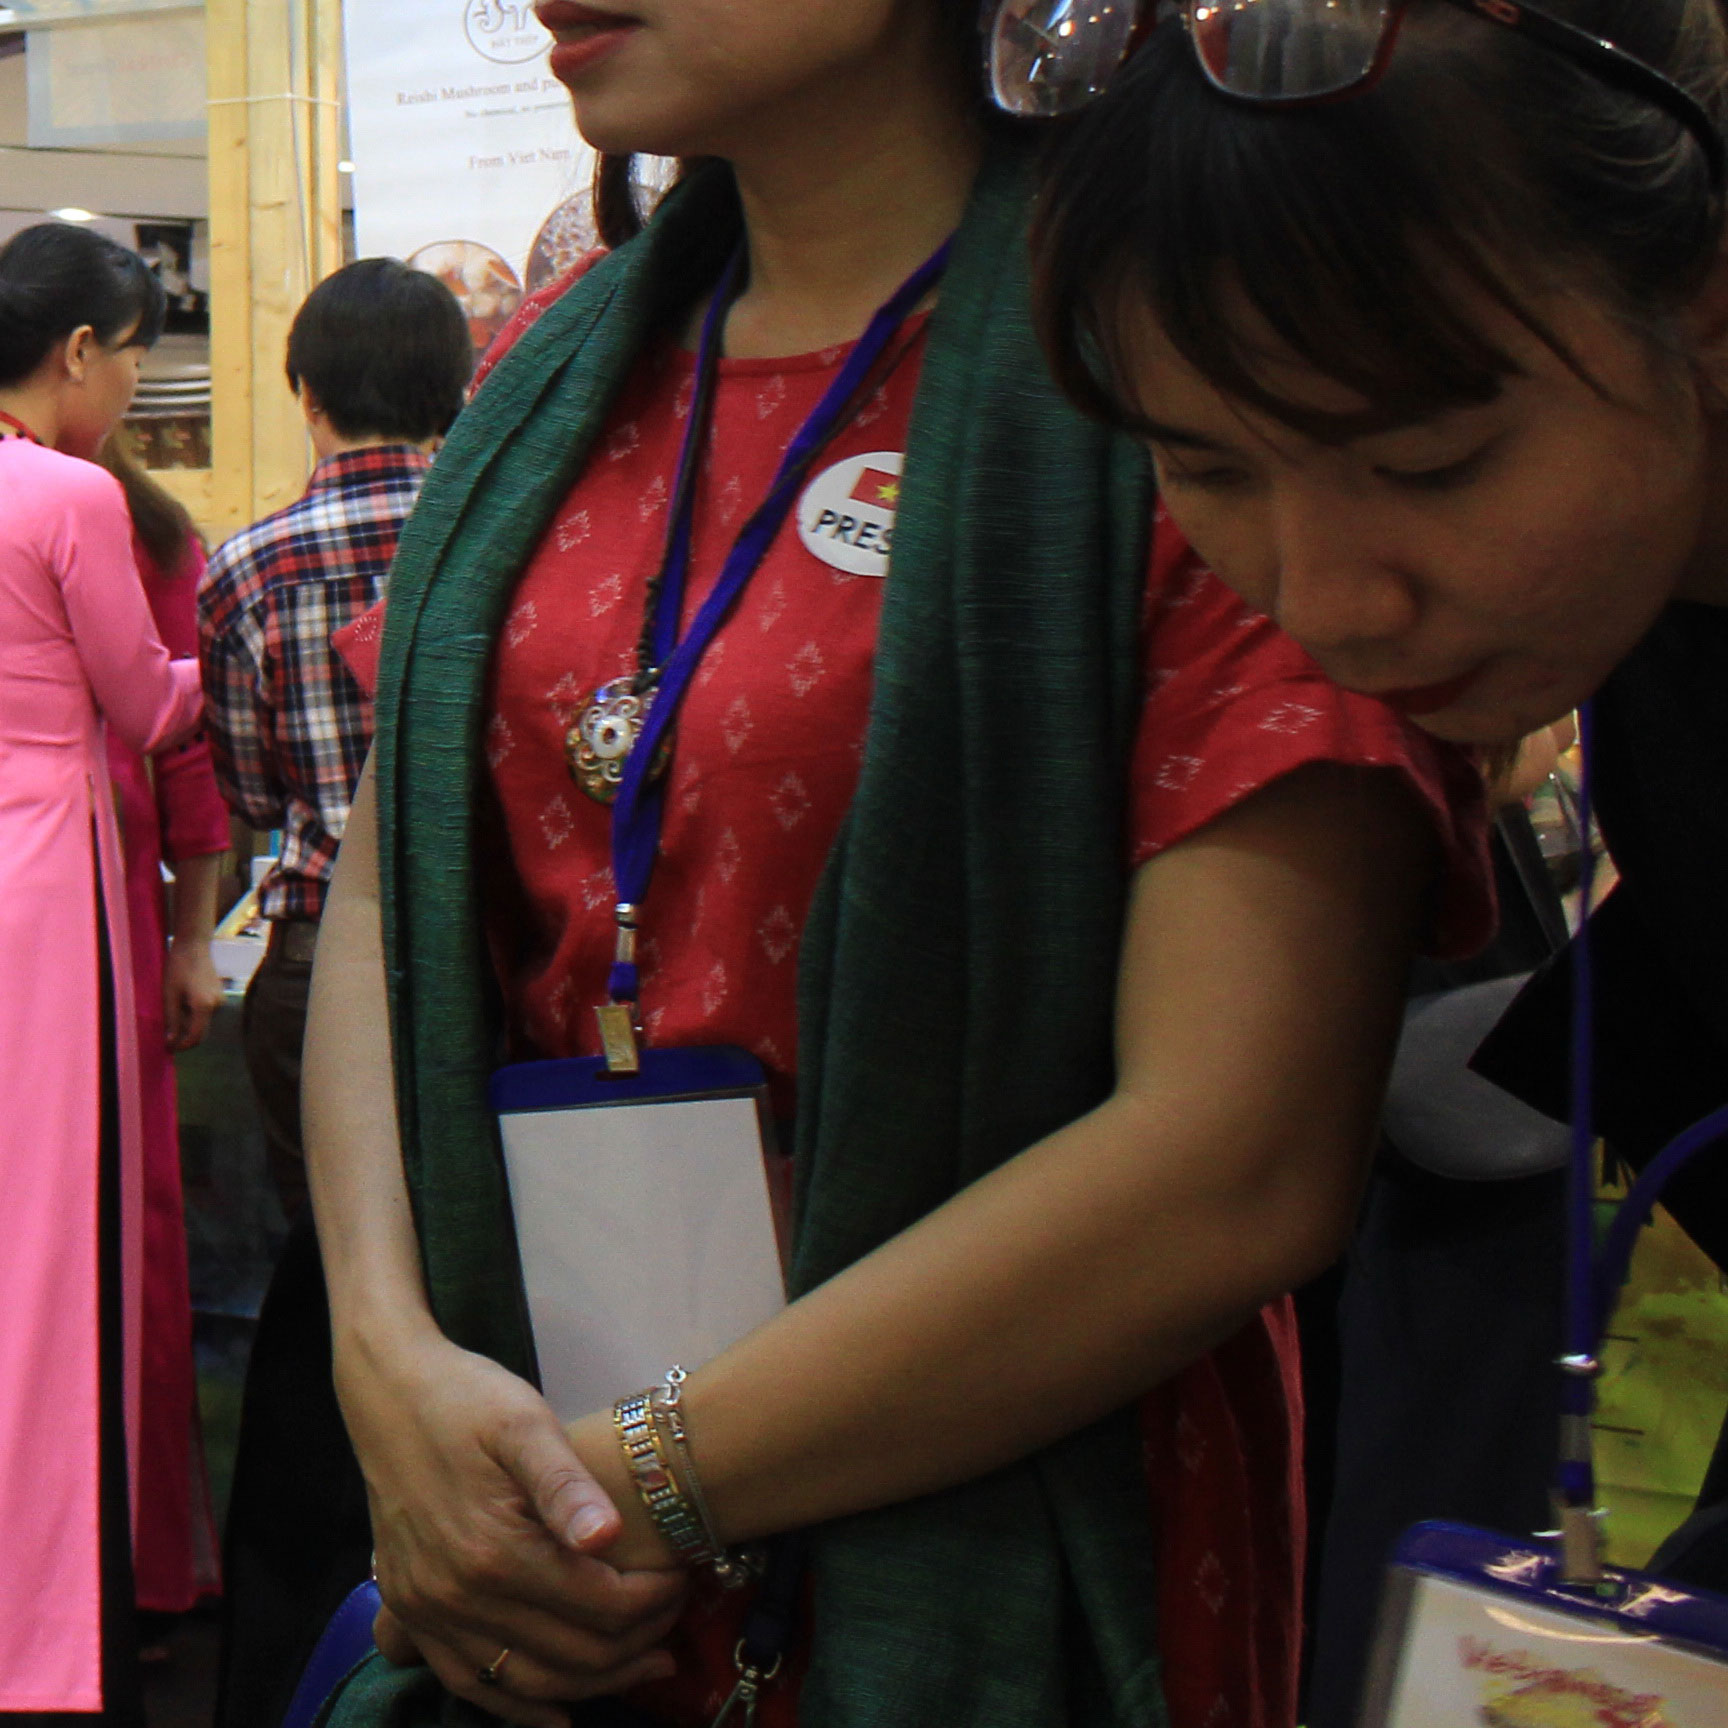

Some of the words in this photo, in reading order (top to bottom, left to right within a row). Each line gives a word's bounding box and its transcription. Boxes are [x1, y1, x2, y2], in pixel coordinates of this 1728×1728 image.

[441, 83, 511, 101] Mushroom
[513, 78, 538, 92] and
[468, 154, 504, 170] From
[508, 151, 536, 165] Viet
[811, 508, 893, 555] PRES
